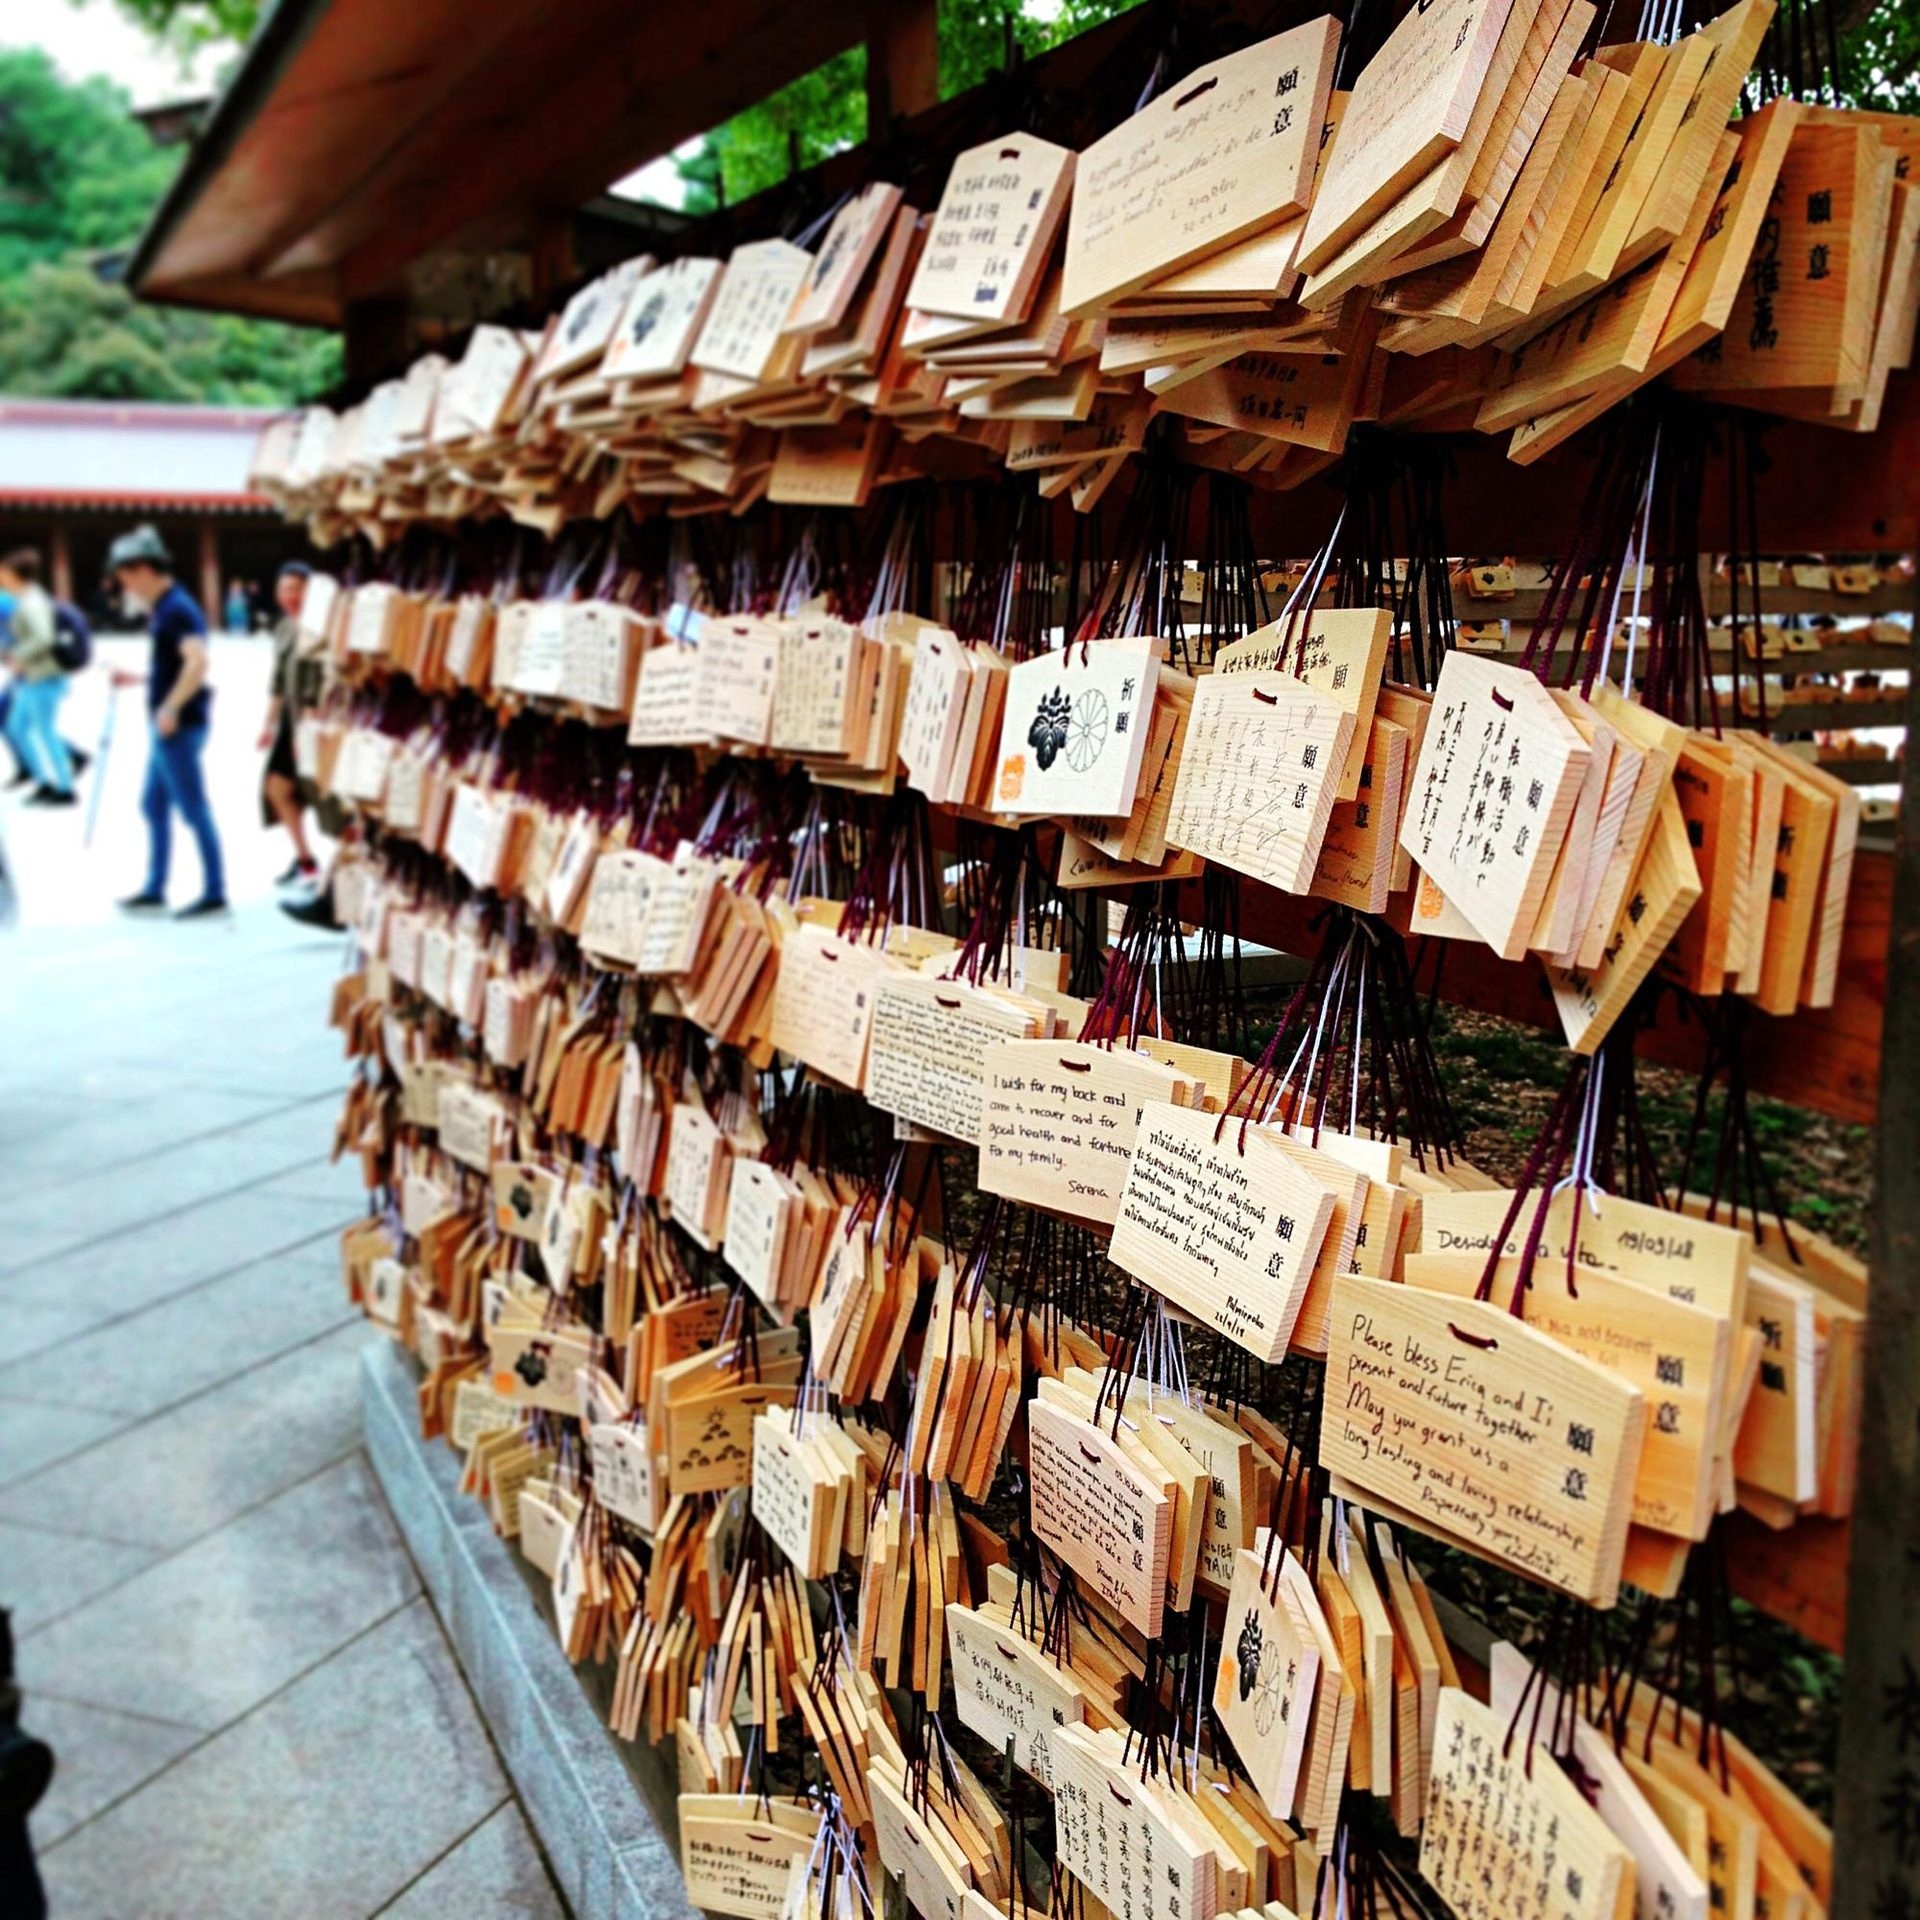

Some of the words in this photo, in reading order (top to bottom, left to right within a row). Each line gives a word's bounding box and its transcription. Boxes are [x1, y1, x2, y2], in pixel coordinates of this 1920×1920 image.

[1270, 65, 1300, 137] 願意
[1291, 744, 1319, 809] 願意
[1001, 1077, 1025, 1091] wish
[1030, 1079, 1045, 1093] for
[1051, 1084, 1067, 1103] my
[1072, 1086, 1097, 1102] back
[1103, 1093, 1125, 1107] and
[1030, 1107, 1065, 1121] recover
[1072, 1113, 1092, 1125] and
[1099, 1116, 1118, 1129] for
[989, 1123, 1015, 1139] good
[1019, 1124, 1055, 1143] health
[1061, 1134, 1081, 1147] and
[1008, 1149, 1023, 1166] my
[1068, 1180, 1109, 1198] Serena
[1265, 1215, 1295, 1279] 願意
[1352, 1314, 1393, 1357] Please
[1403, 1336, 1439, 1374] bless
[1445, 1356, 1486, 1399] Erica
[1493, 1391, 1523, 1412] and
[1652, 1354, 1685, 1434] 願意
[1347, 1382, 1385, 1428] May
[1393, 1412, 1416, 1436] you
[1422, 1427, 1464, 1448] grant
[1470, 1444, 1492, 1465] us
[1499, 1459, 1509, 1474] a
[1348, 1354, 1395, 1383] present
[1400, 1375, 1424, 1401] and
[1426, 1385, 1468, 1416] future
[1475, 1404, 1537, 1445] together
[1343, 1421, 1370, 1460] long
[1377, 1437, 1422, 1479] lasting
[1429, 1468, 1454, 1488] and
[1461, 1478, 1497, 1518] loving
[1507, 1503, 1585, 1550] relationship
[1561, 1422, 1594, 1501] 願意
[1212, 1476, 1228, 1530] 願意
[1101, 1583, 1122, 1610] ITALY
